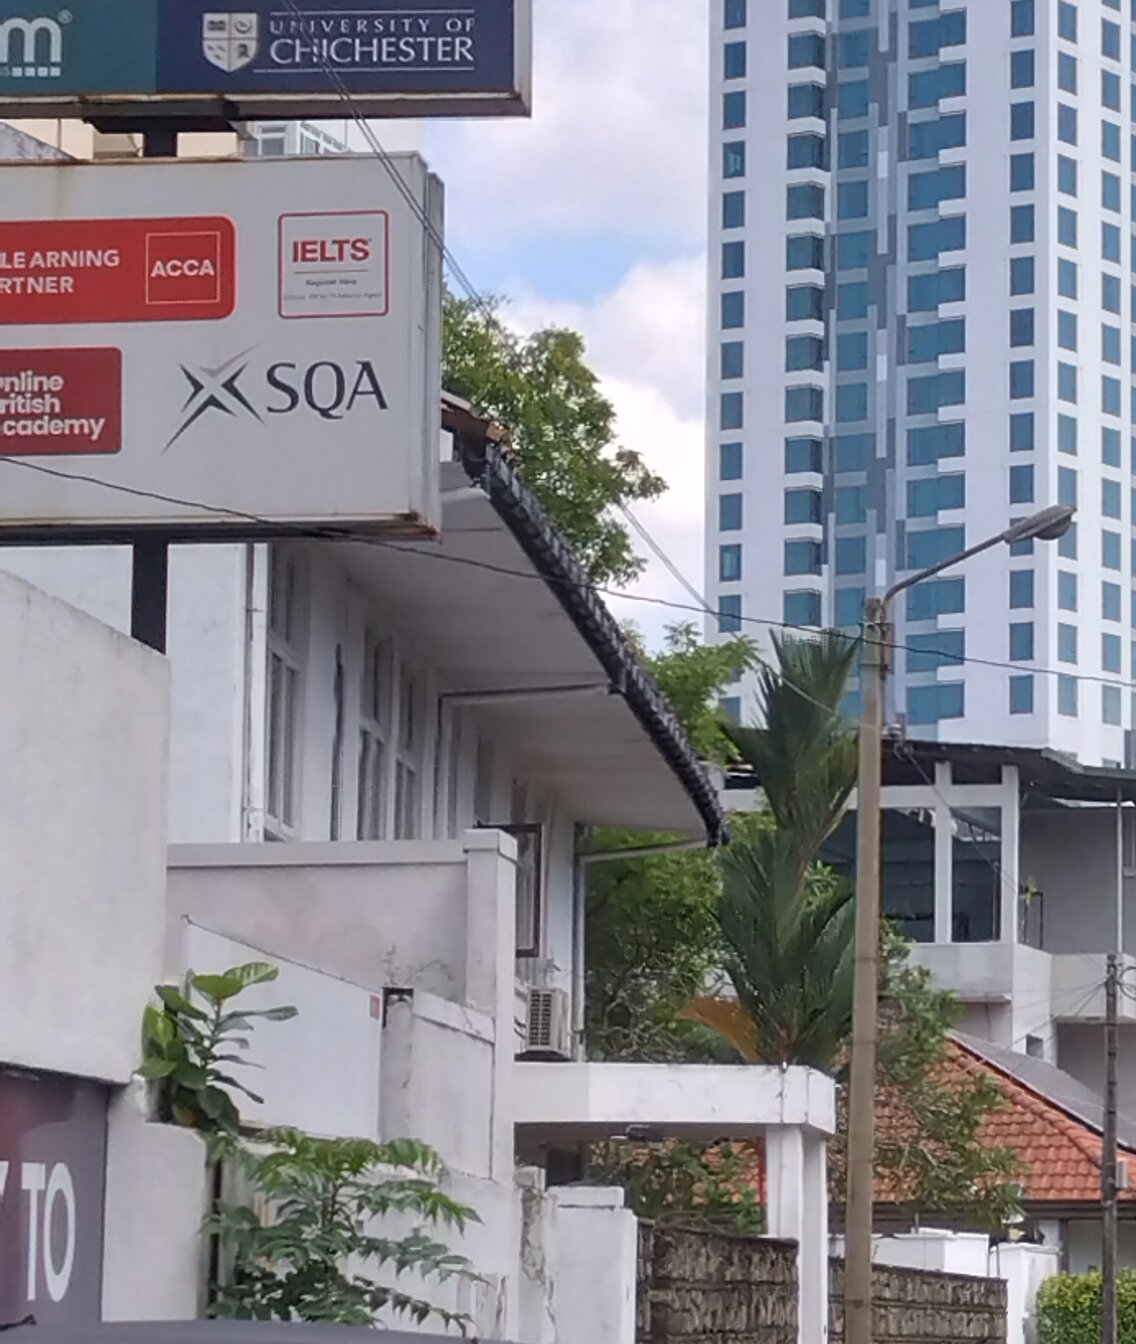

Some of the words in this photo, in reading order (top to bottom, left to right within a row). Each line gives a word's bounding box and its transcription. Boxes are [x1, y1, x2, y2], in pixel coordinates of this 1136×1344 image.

[270, 18, 430, 35] UNIVERSITY
[445, 17, 475, 33] OF
[270, 37, 474, 64] CHICHESTER
[292, 237, 370, 263] IELTS
[150, 259, 215, 277] ACCA
[0, 275, 75, 294] RTNER
[0, 369, 64, 392] nline
[266, 361, 388, 419] SQA
[0, 415, 105, 441] cademy
